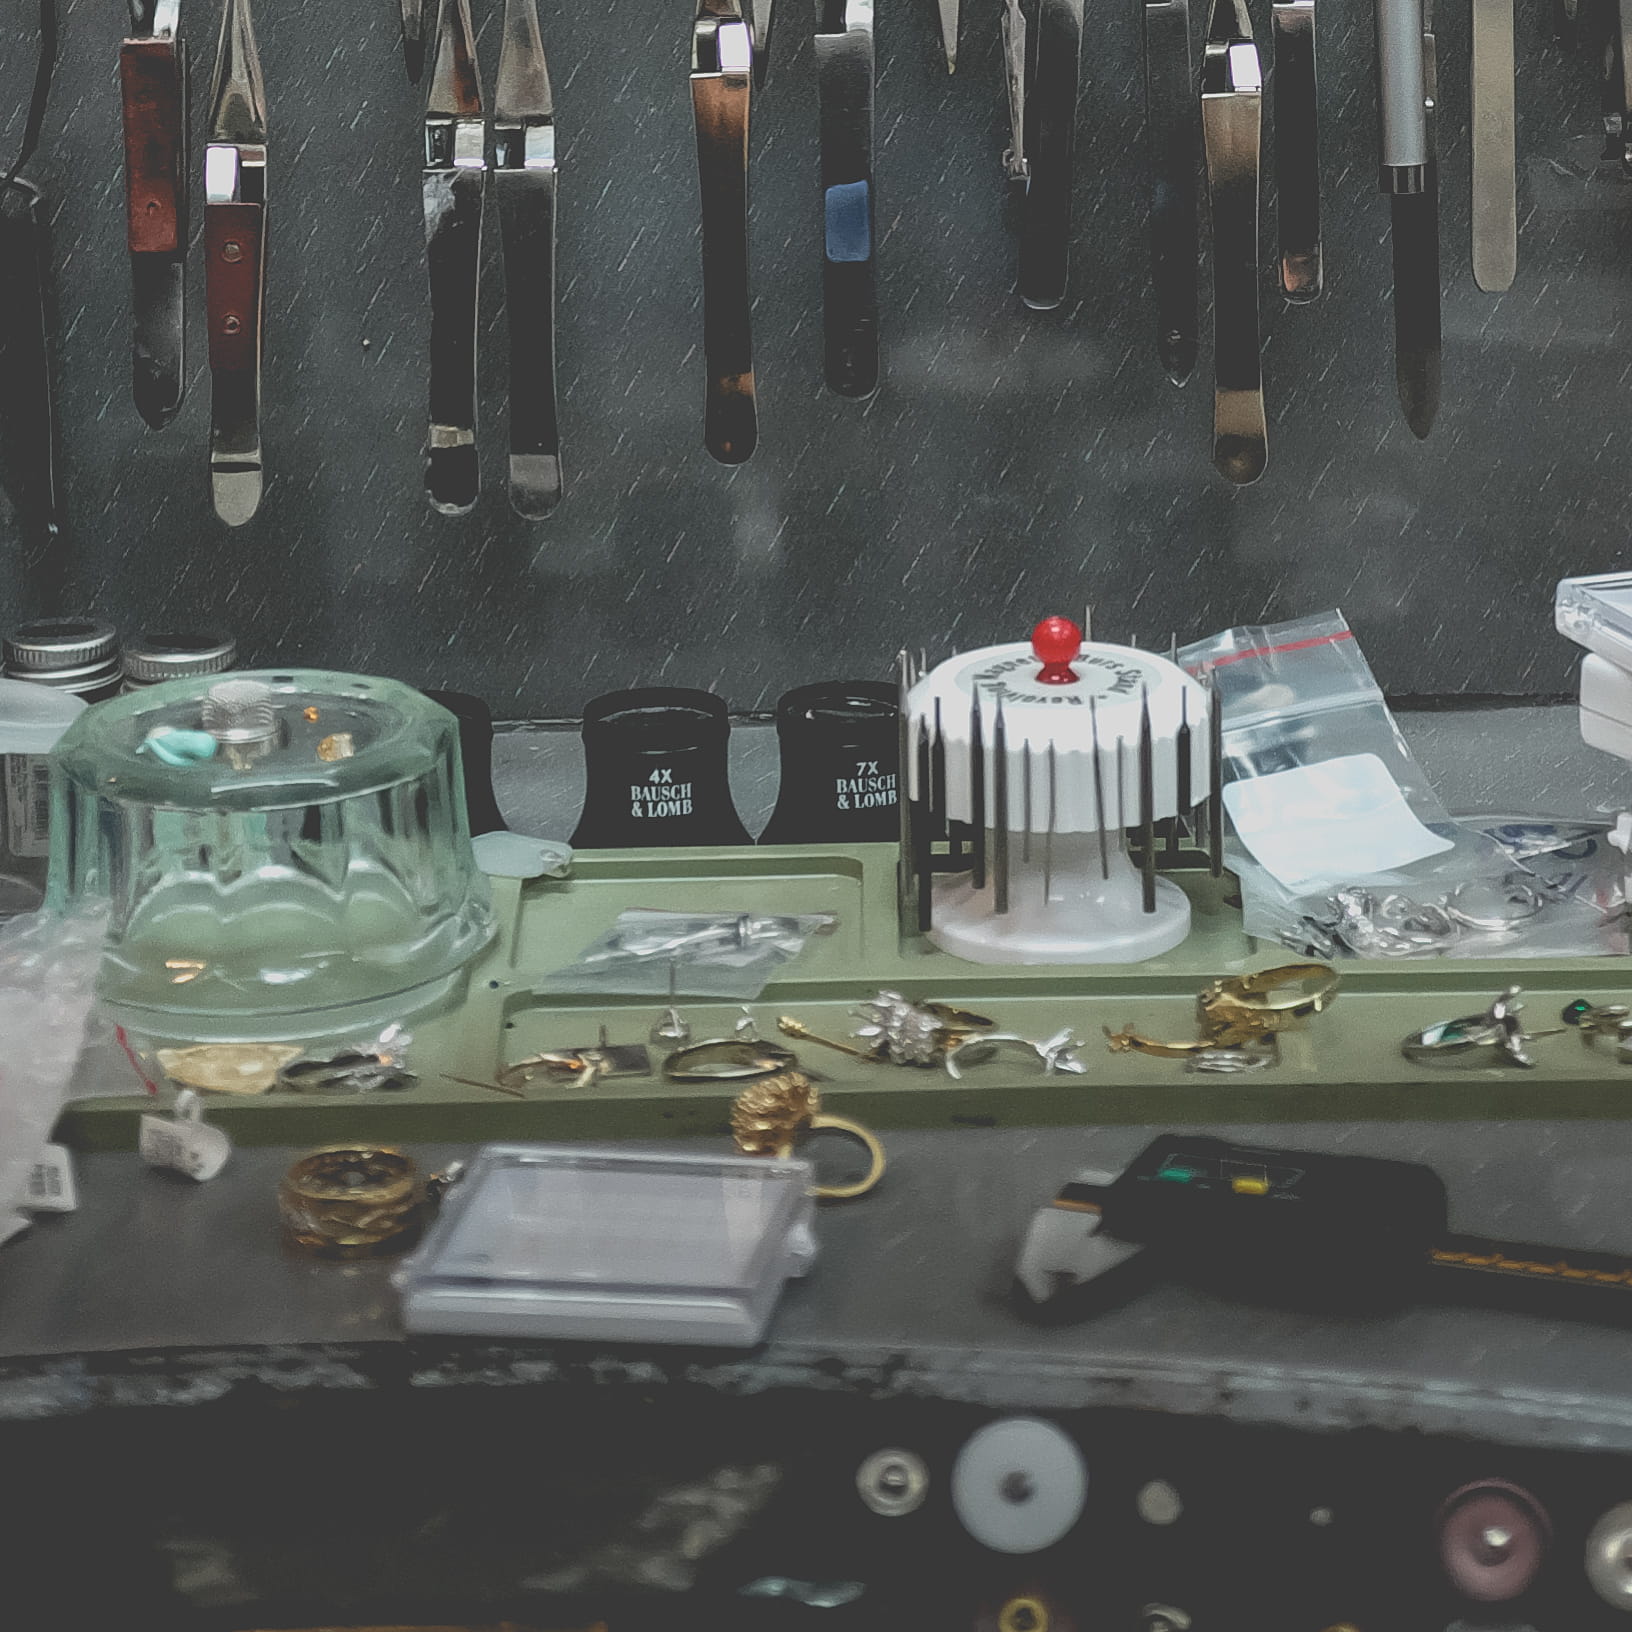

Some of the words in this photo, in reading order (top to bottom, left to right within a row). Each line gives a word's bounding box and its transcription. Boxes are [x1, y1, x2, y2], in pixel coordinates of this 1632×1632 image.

[649, 768, 673, 784] 4X
[856, 761, 879, 776] 7X
[630, 783, 692, 801] BAUSCH
[836, 773, 897, 794] BAUSCH
[631, 802, 643, 818] &
[647, 799, 693, 818] LOMB
[836, 794, 850, 810] &
[854, 790, 898, 809] LOMB
